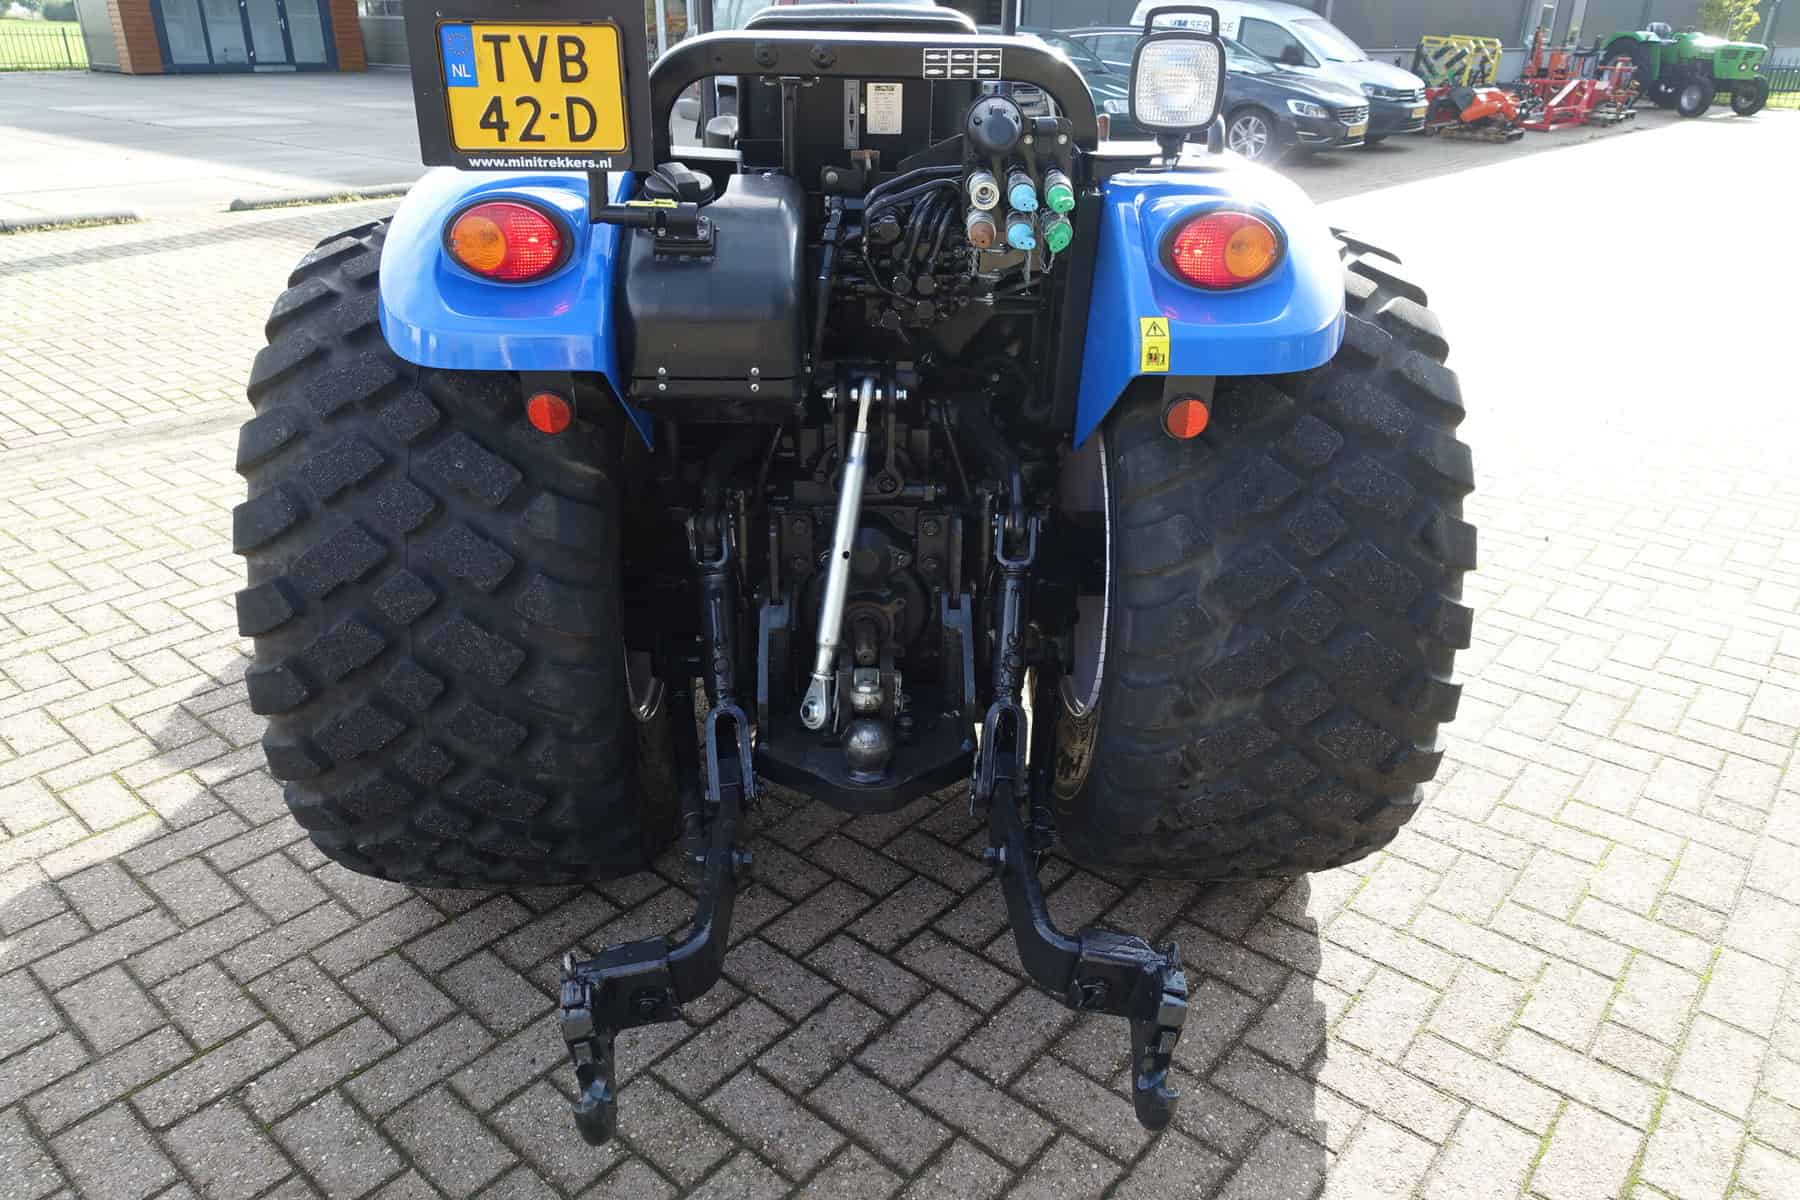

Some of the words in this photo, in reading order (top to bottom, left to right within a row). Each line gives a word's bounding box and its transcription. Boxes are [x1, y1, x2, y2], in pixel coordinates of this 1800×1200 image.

[1190, 20, 1234, 32] SERCE
[482, 34, 588, 83] TVB
[451, 64, 471, 78] NL
[479, 96, 597, 142] 42-D
[467, 156, 612, 169] www.minitrekkers.nl
